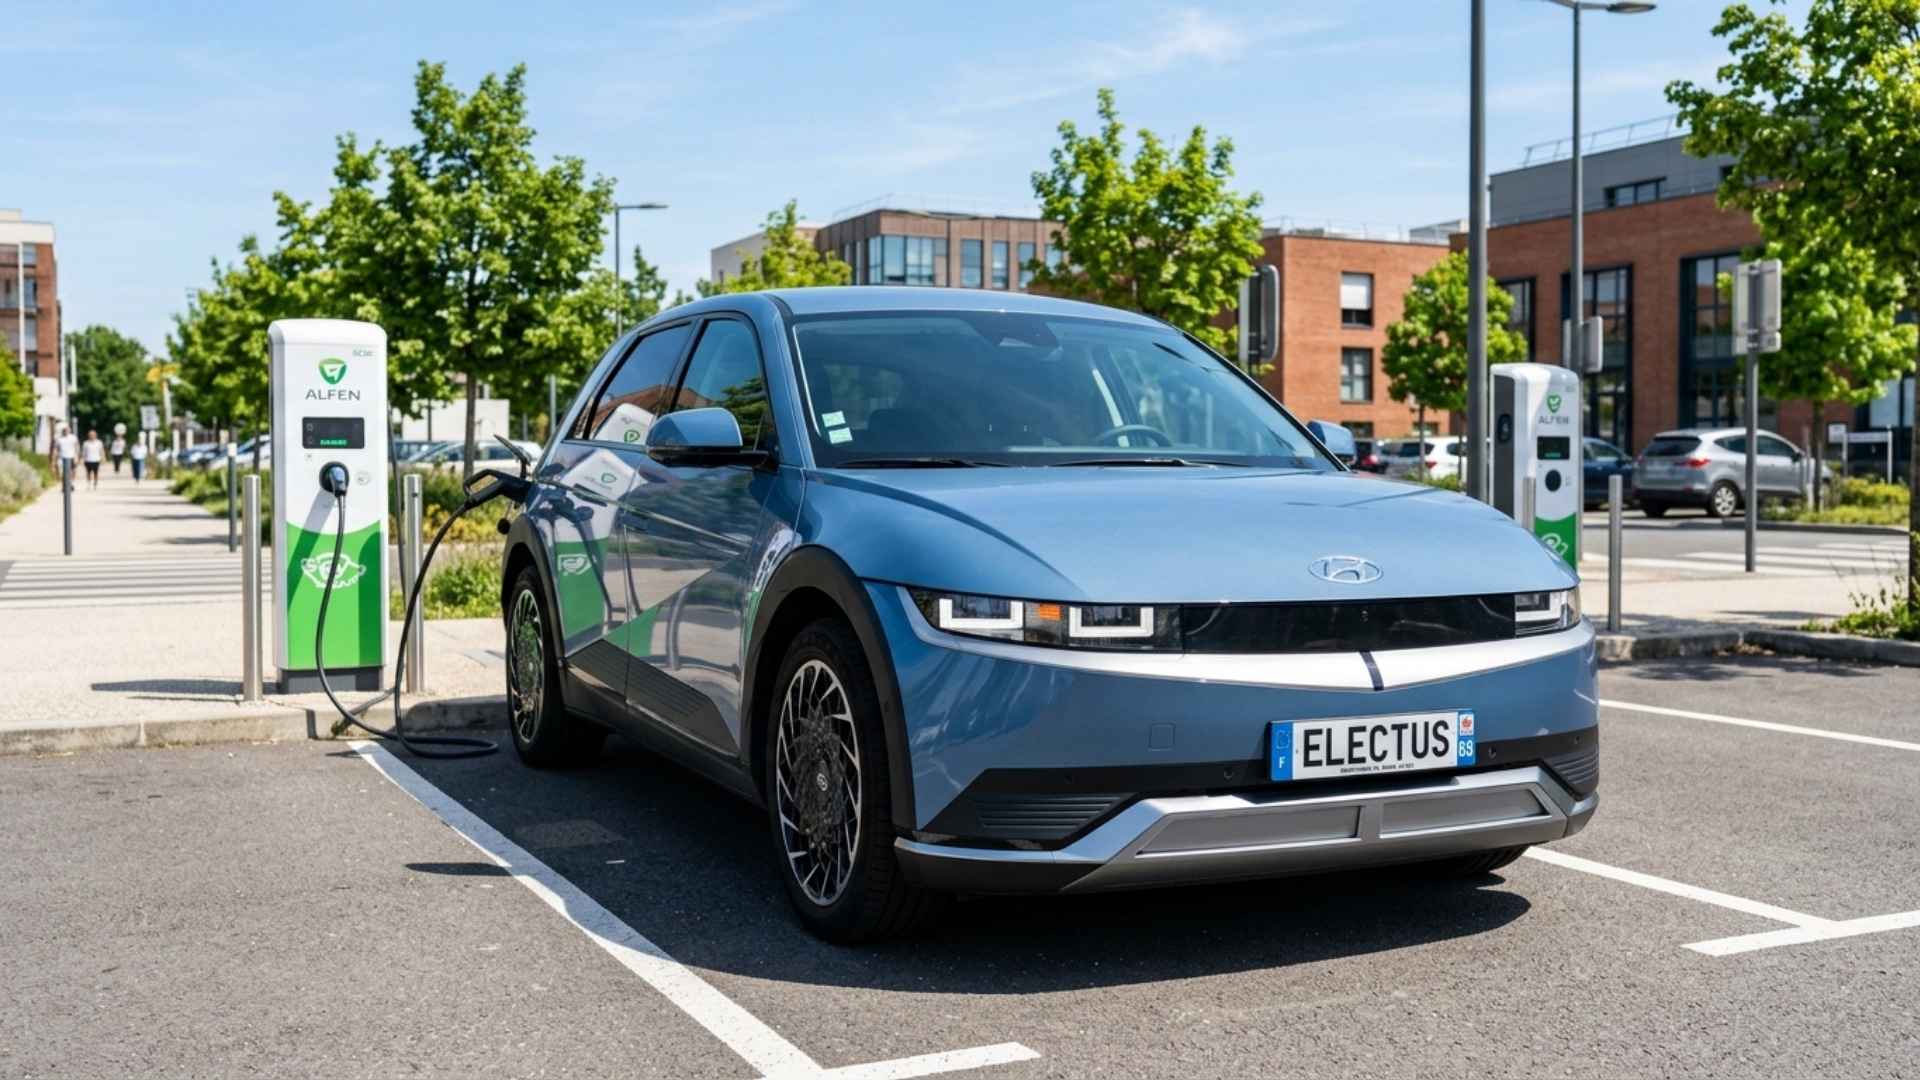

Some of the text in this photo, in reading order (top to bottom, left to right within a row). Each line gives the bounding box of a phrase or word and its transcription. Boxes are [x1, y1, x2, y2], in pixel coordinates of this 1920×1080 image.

[305, 389, 360, 401] ALFEN
[1303, 720, 1450, 768] ELECTUS
[1279, 756, 1285, 769] F
